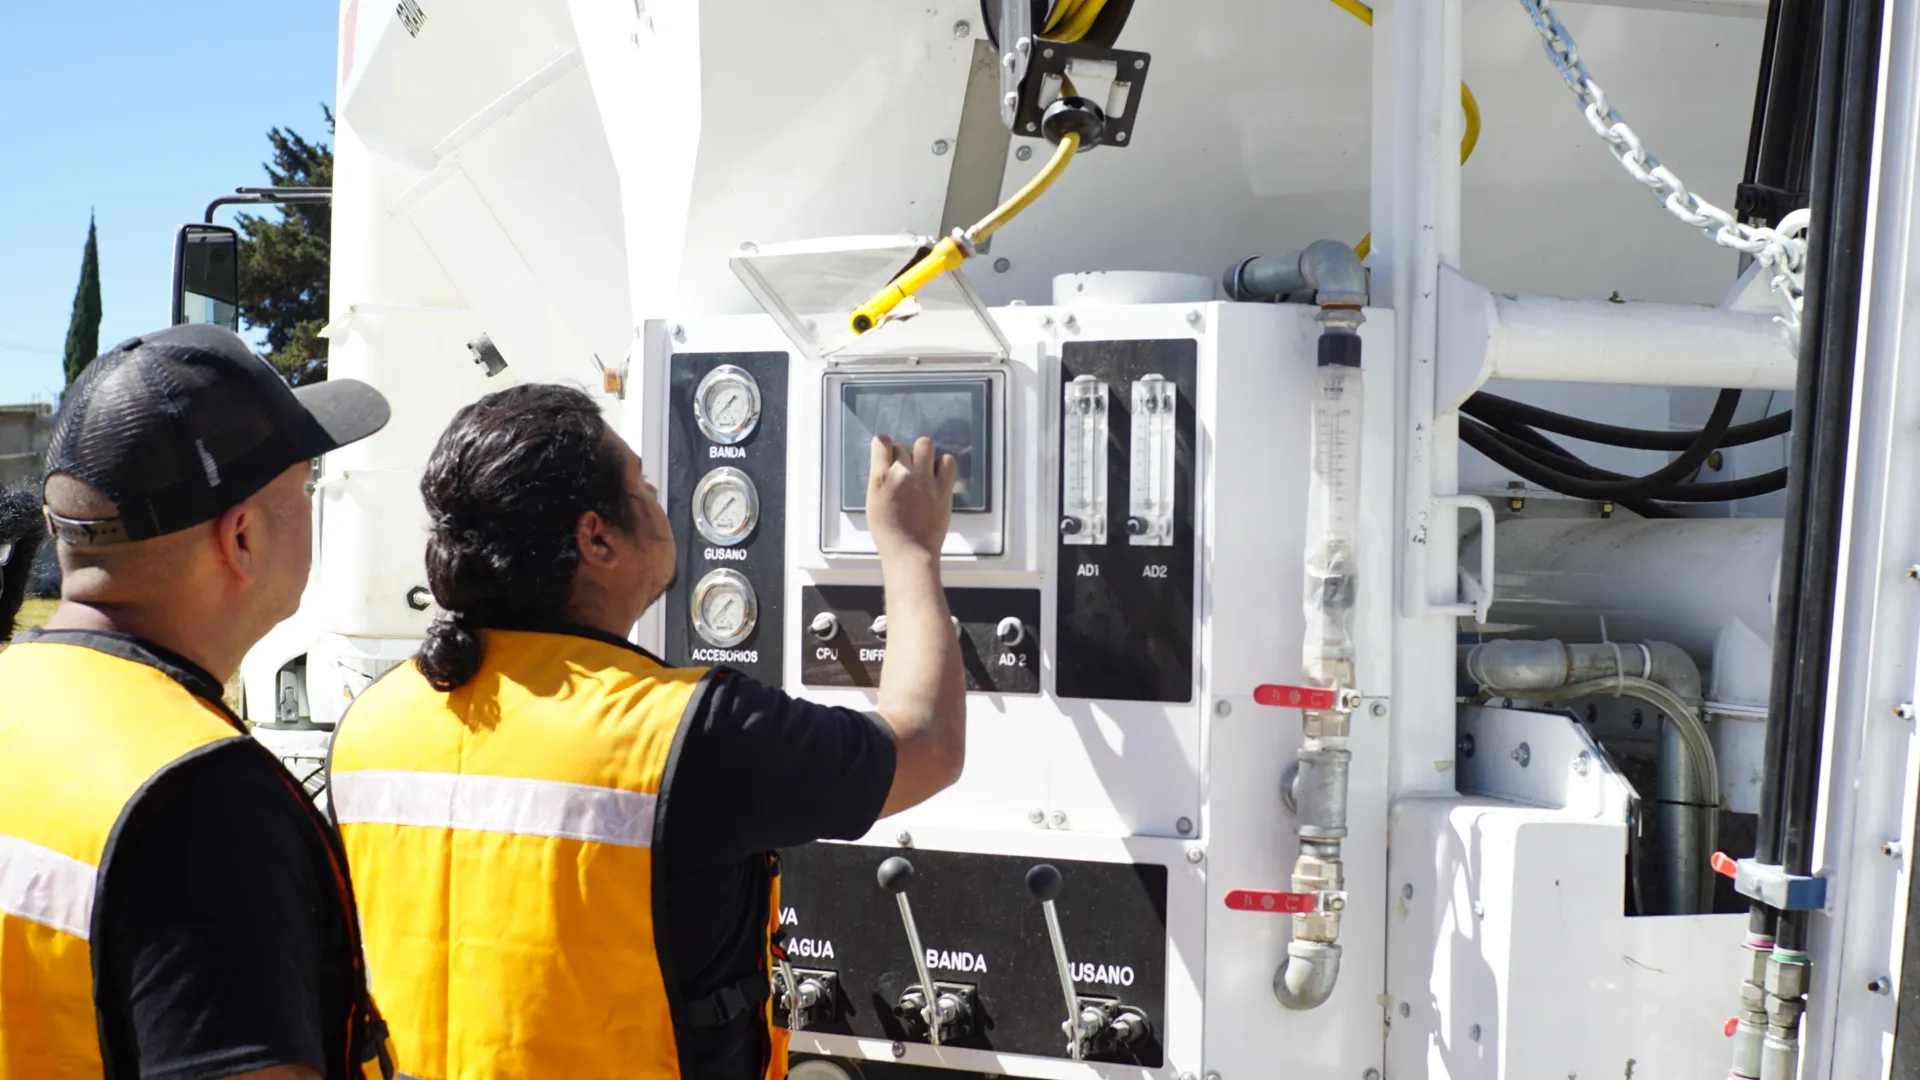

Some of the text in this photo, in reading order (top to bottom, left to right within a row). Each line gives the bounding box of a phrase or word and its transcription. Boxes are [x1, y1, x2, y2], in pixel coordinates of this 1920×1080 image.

[709, 446, 746, 458] BANDA
[704, 548, 747, 561] GUSANO
[1077, 564, 1099, 577] AD1
[1142, 565, 1168, 578] AD2
[691, 649, 758, 663] ACCESORIOS
[816, 647, 838, 660] CPU
[998, 652, 1027, 667] AD 2
[778, 907, 798, 925] VA
[786, 937, 835, 959] AGUA
[926, 948, 987, 973] BANDA
[1068, 962, 1135, 986] USANO
